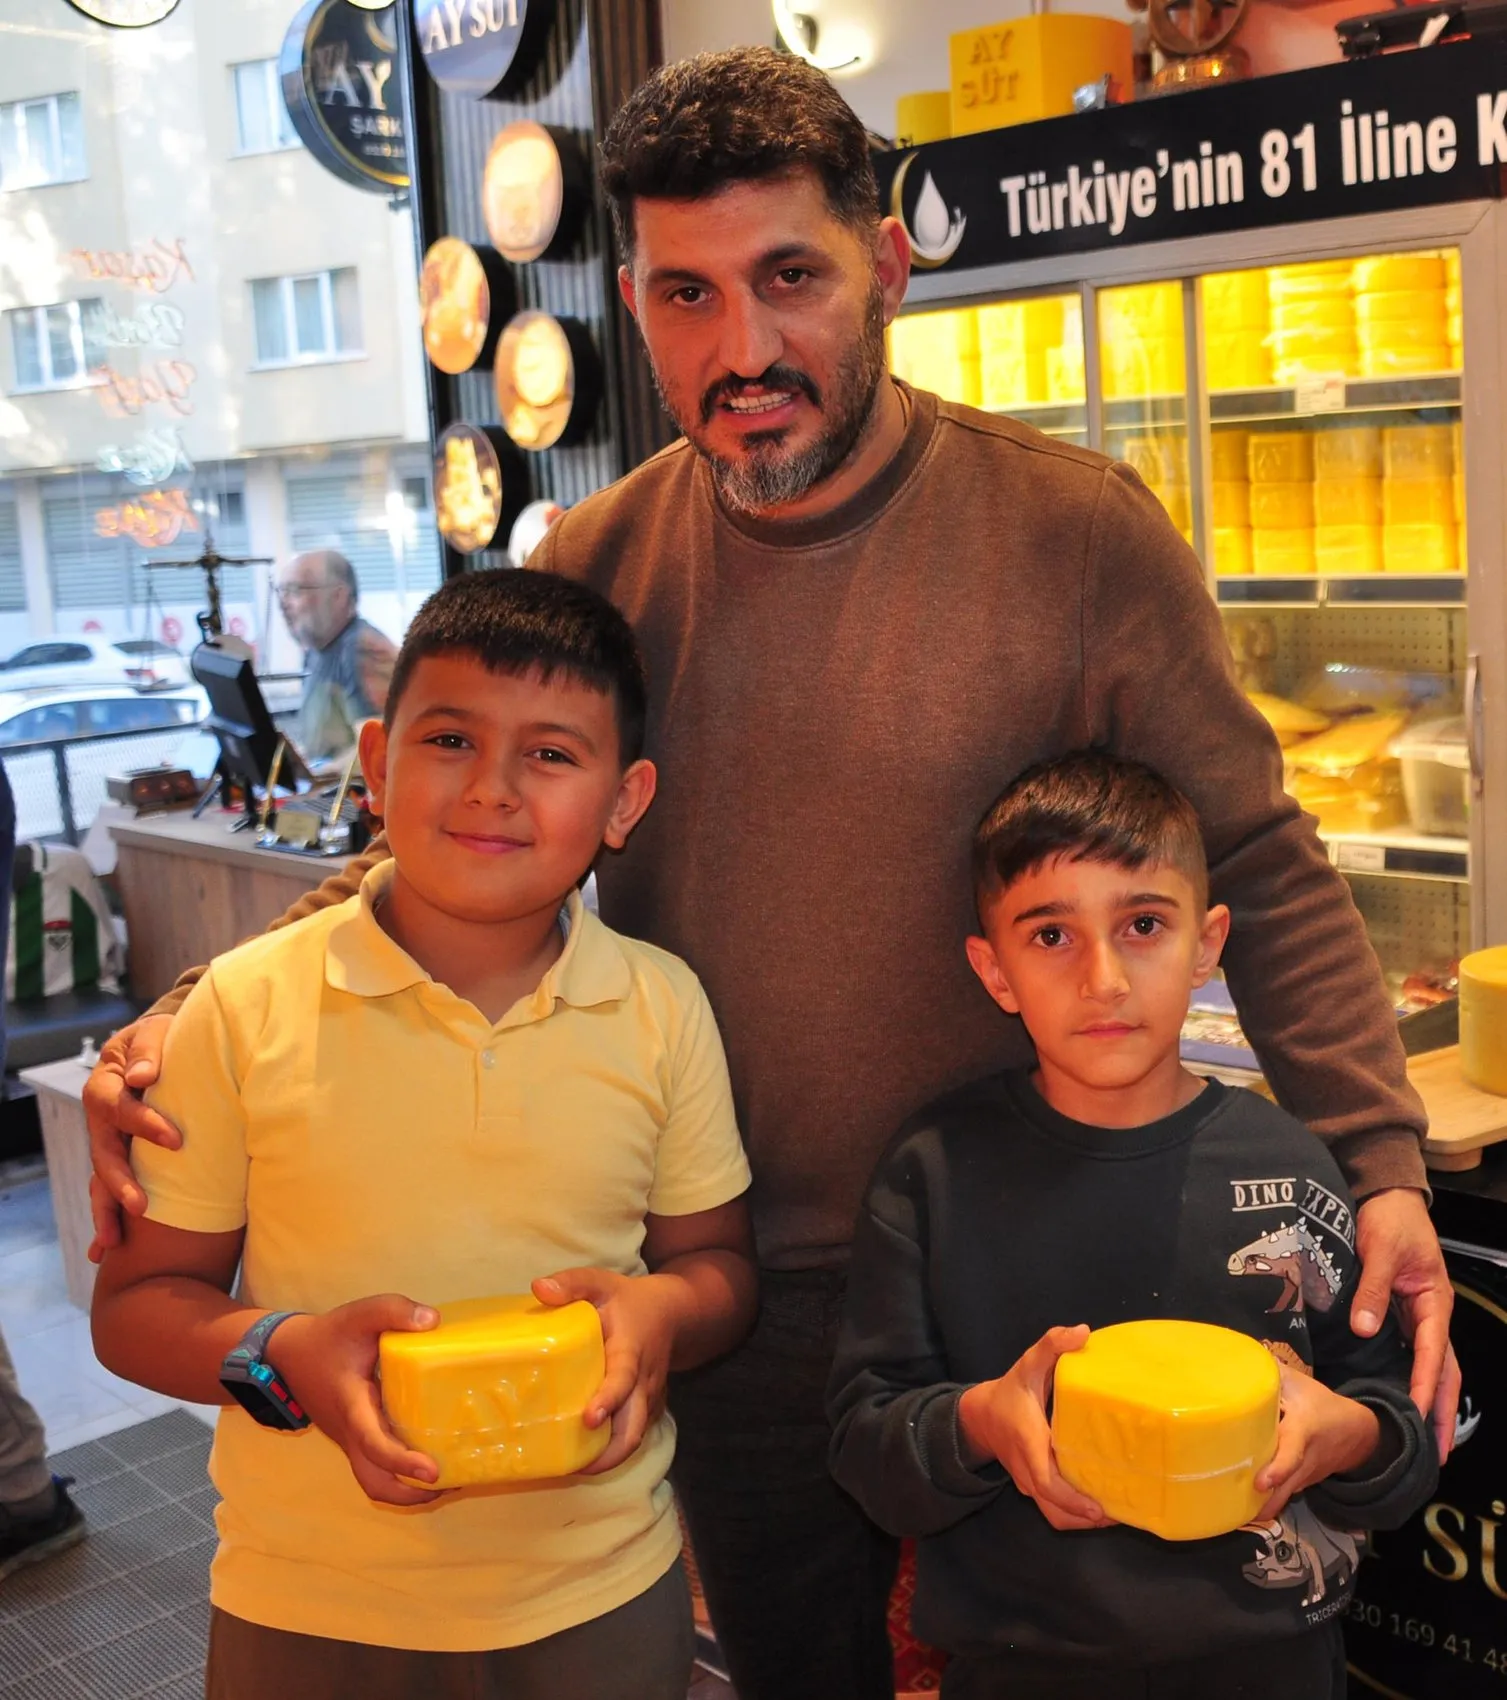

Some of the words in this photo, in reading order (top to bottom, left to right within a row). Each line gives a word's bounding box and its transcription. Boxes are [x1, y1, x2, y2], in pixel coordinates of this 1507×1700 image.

[969, 28, 1014, 67] AY
[323, 58, 392, 110] AY
[1000, 141, 1244, 237] Türkiye'nin
[1260, 122, 1317, 199] 81
[1340, 99, 1457, 187] İline
[1234, 1182, 1294, 1208] DINO
[1289, 1317, 1307, 1330] AN
[1346, 1598, 1382, 1628] 30
[1389, 1613, 1436, 1647] 169
[1442, 1633, 1475, 1664] 41
